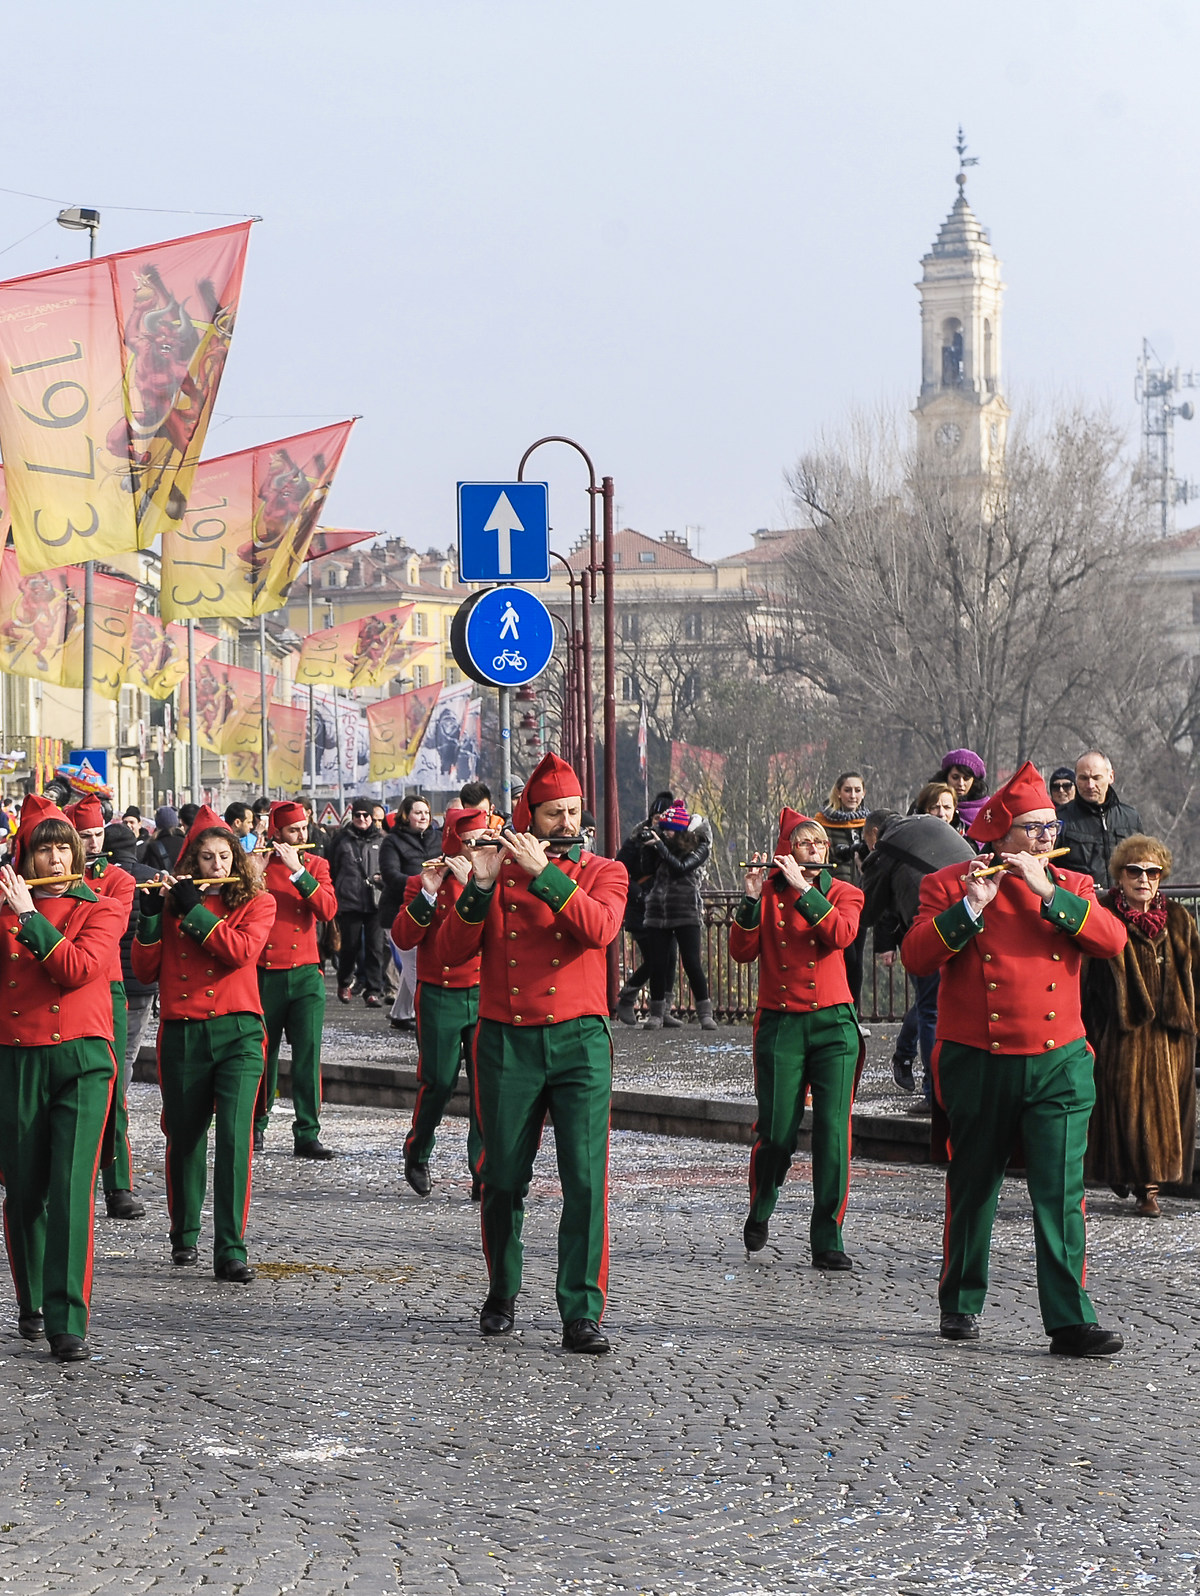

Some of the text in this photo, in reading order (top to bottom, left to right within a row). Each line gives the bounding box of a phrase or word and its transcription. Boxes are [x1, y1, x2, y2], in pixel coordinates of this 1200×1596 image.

[10, 339, 100, 547] 1973
[171, 496, 227, 606] 1973
[92, 602, 130, 689] 1973
[303, 633, 339, 678] 1973
[280, 729, 302, 786] 1973
[373, 718, 396, 776] 1973
